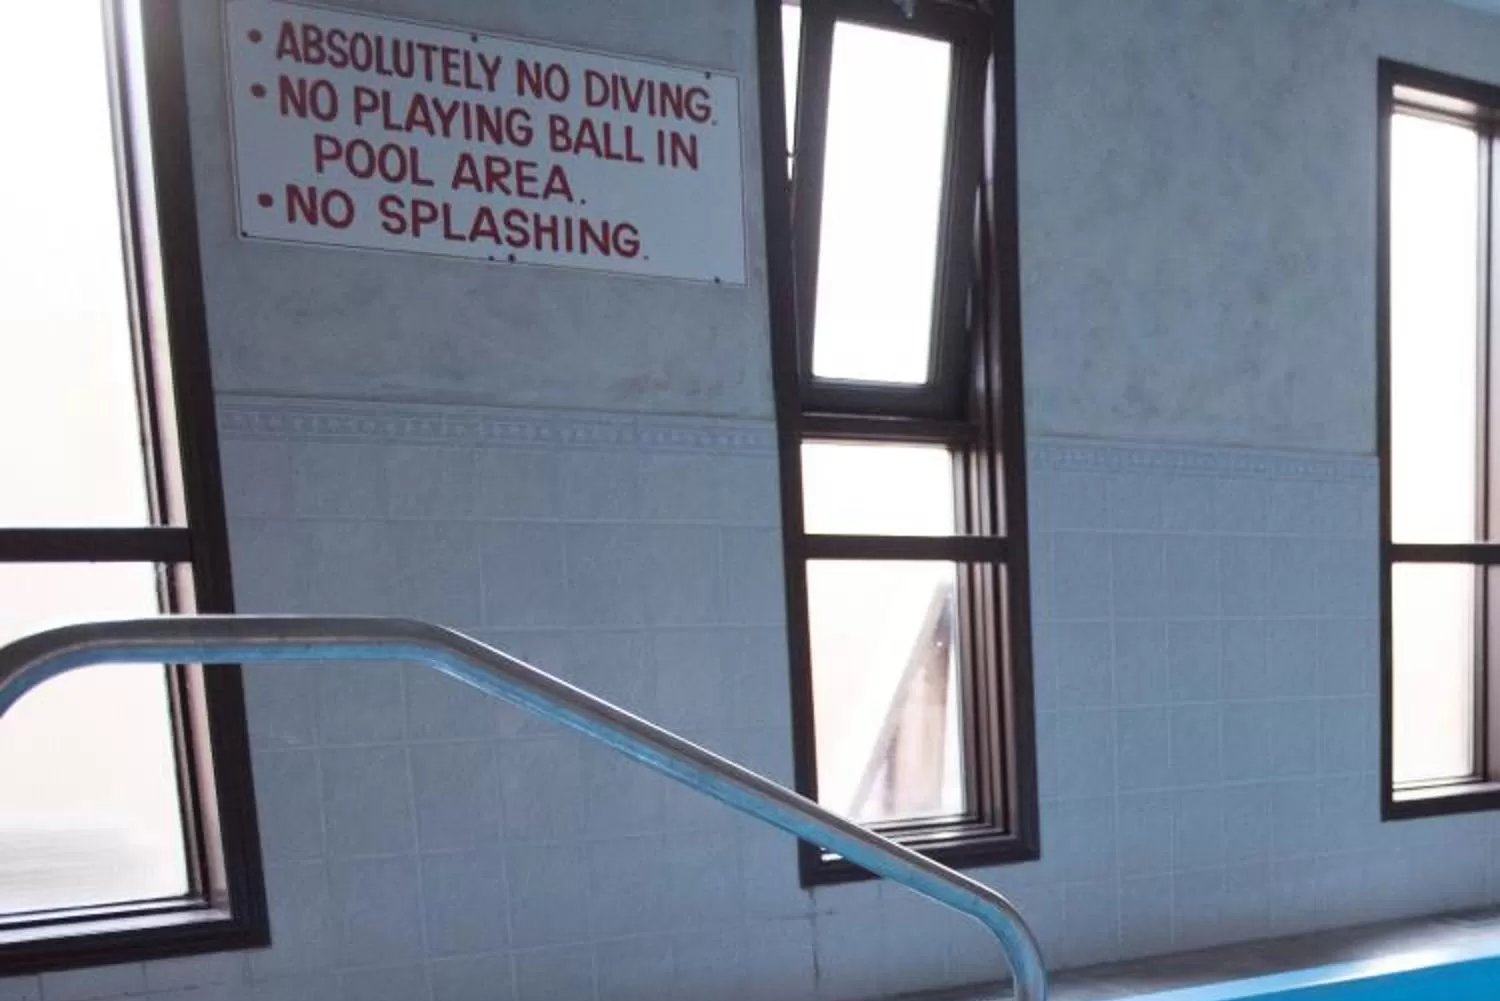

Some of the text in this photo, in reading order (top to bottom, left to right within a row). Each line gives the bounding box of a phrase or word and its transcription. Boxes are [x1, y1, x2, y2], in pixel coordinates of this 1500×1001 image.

[276, 20, 718, 126] ABSOLUTELY NO DIVING.
[279, 75, 698, 170] NO PLAYING BALL IN
[313, 134, 587, 205] POOL AREA.
[286, 184, 649, 260] NO SPLASHING.
